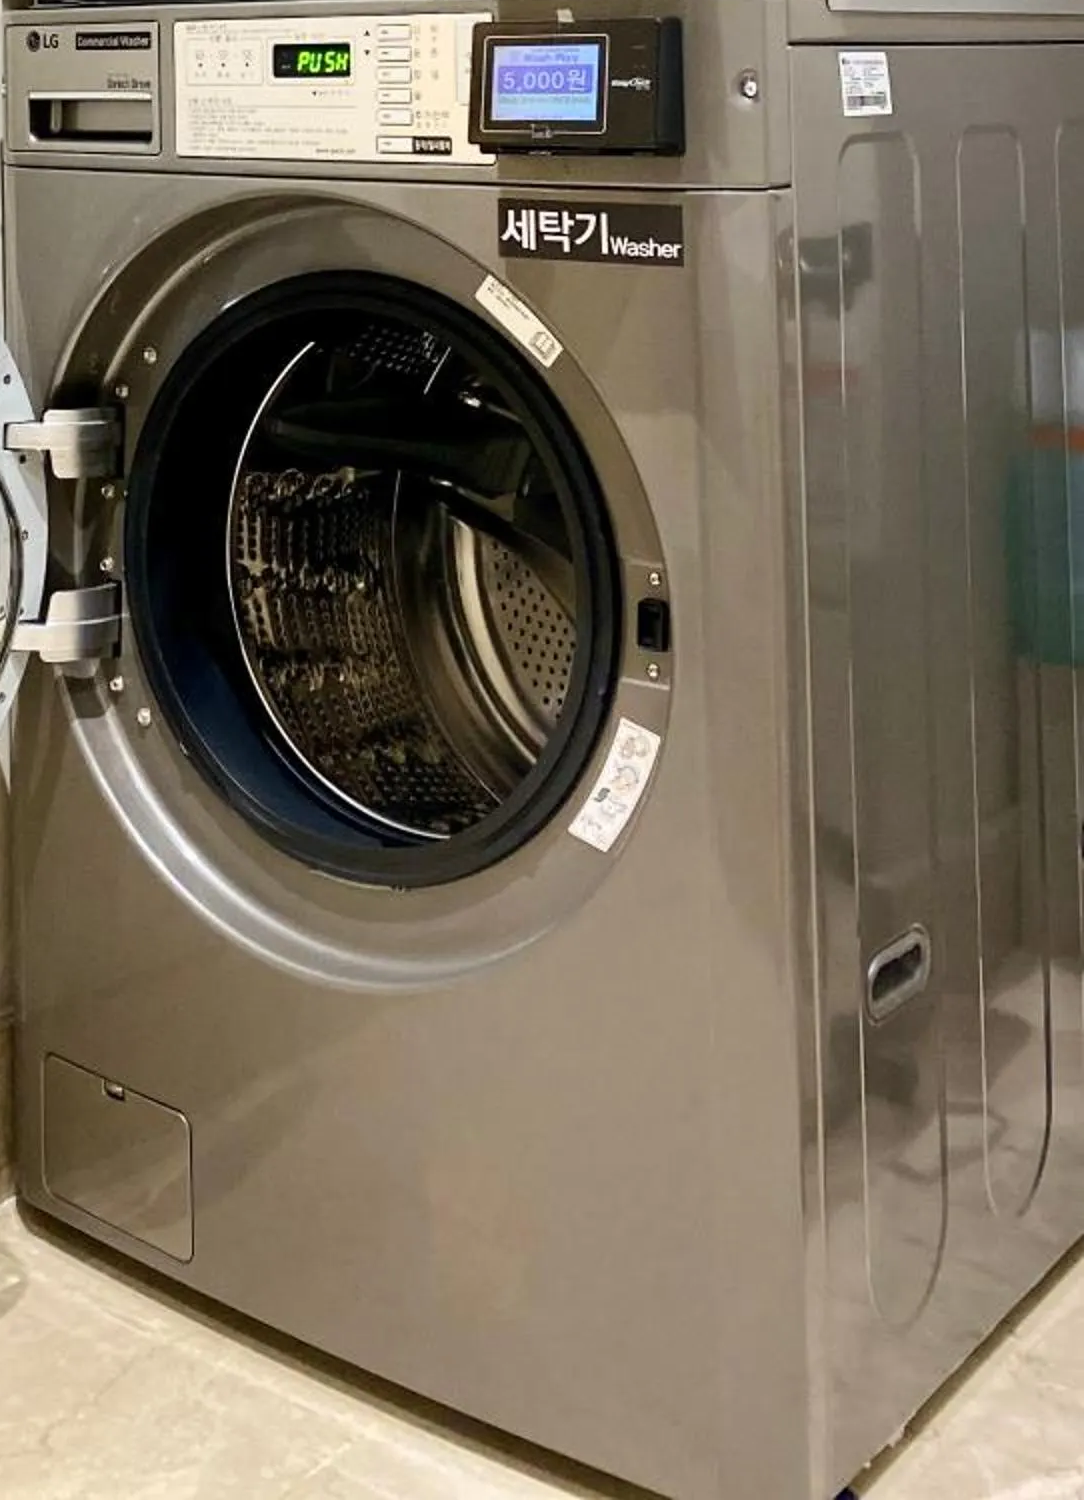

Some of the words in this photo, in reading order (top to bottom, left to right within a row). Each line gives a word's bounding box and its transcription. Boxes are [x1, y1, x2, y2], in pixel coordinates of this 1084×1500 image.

[43, 33, 59, 49] LG
[297, 51, 349, 73] PUSH
[503, 68, 587, 92] 5,000원
[501, 209, 608, 255] 세탁기
[610, 236, 682, 258] Washer
